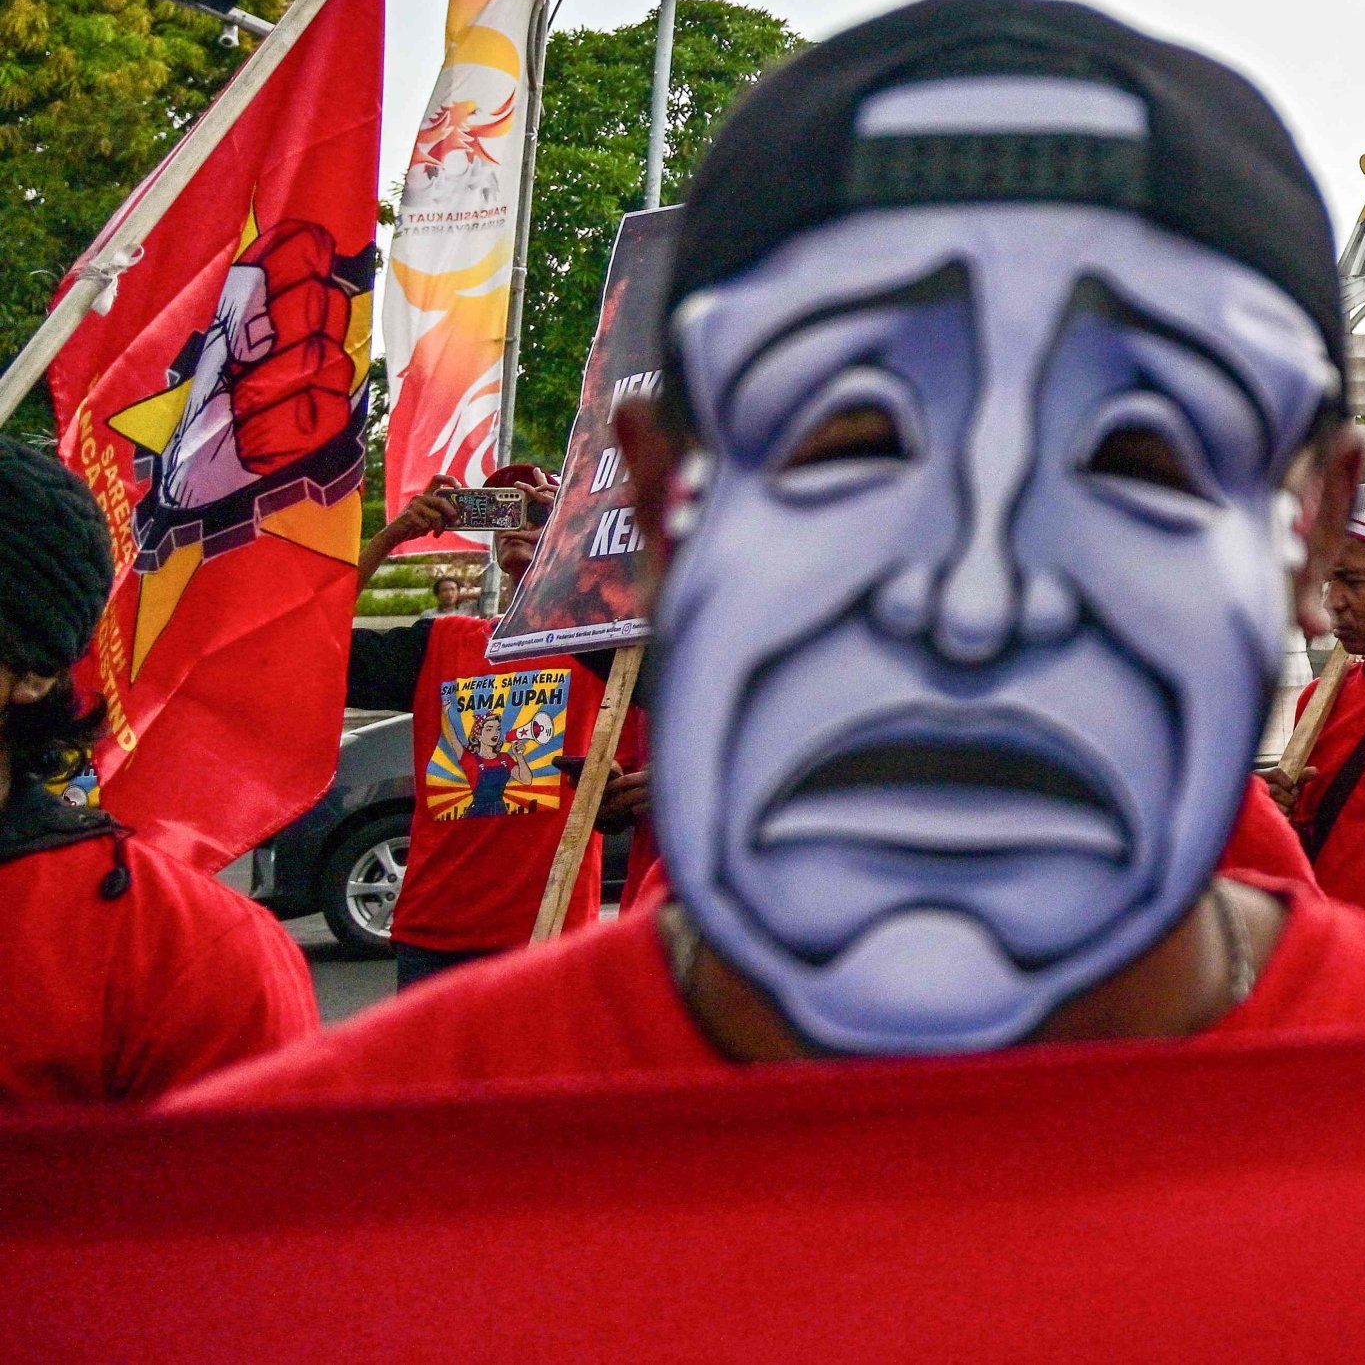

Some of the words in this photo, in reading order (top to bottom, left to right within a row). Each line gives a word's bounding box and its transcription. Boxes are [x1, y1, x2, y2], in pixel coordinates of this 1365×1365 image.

[462, 678, 498, 691] MEREK,
[501, 675, 528, 688] SAMA
[531, 673, 565, 684] KERJA
[457, 693, 505, 713] SAMA
[511, 688, 563, 707] UPAH
